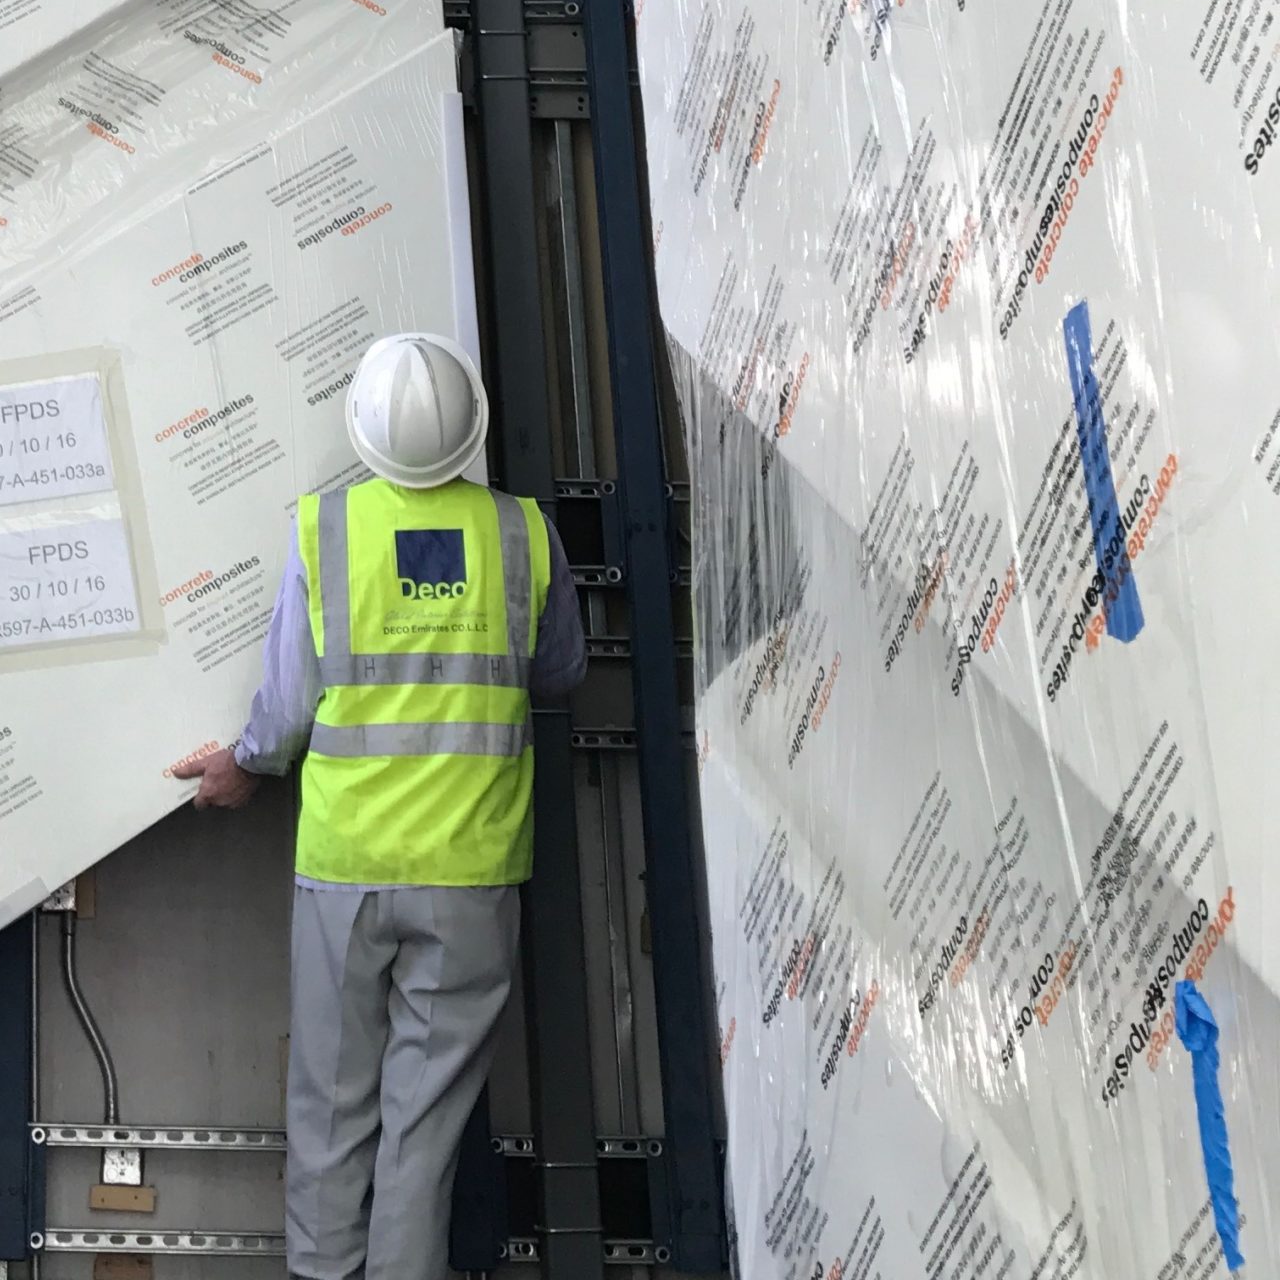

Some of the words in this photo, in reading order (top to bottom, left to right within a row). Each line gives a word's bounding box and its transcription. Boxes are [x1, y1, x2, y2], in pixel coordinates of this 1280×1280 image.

[1080, 66, 1123, 177] concrete
[297, 205, 365, 251] composites
[340, 202, 392, 237] concrete
[1036, 178, 1078, 284] concrete
[152, 252, 204, 287] concrete
[179, 240, 248, 283] composites
[1, 399, 60, 423] FPDS
[154, 406, 209, 442] concrete
[183, 394, 254, 438] composites
[9, 441, 14, 456] /
[20, 438, 40, 454] 10
[45, 436, 50, 450] /
[57, 432, 76, 449] 16
[1128, 454, 1176, 559] concrete
[29, 541, 88, 565] FPDS
[10, 586, 30, 602] 30
[36, 584, 41, 598] /
[48, 581, 68, 597] 10
[74, 579, 78, 594] /
[85, 576, 105, 592] 16
[160, 570, 213, 608] concrete
[187, 555, 260, 604] composites
[398, 578, 467, 600] Deco
[384, 626, 409, 635] DECO
[412, 624, 449, 633] Emirates
